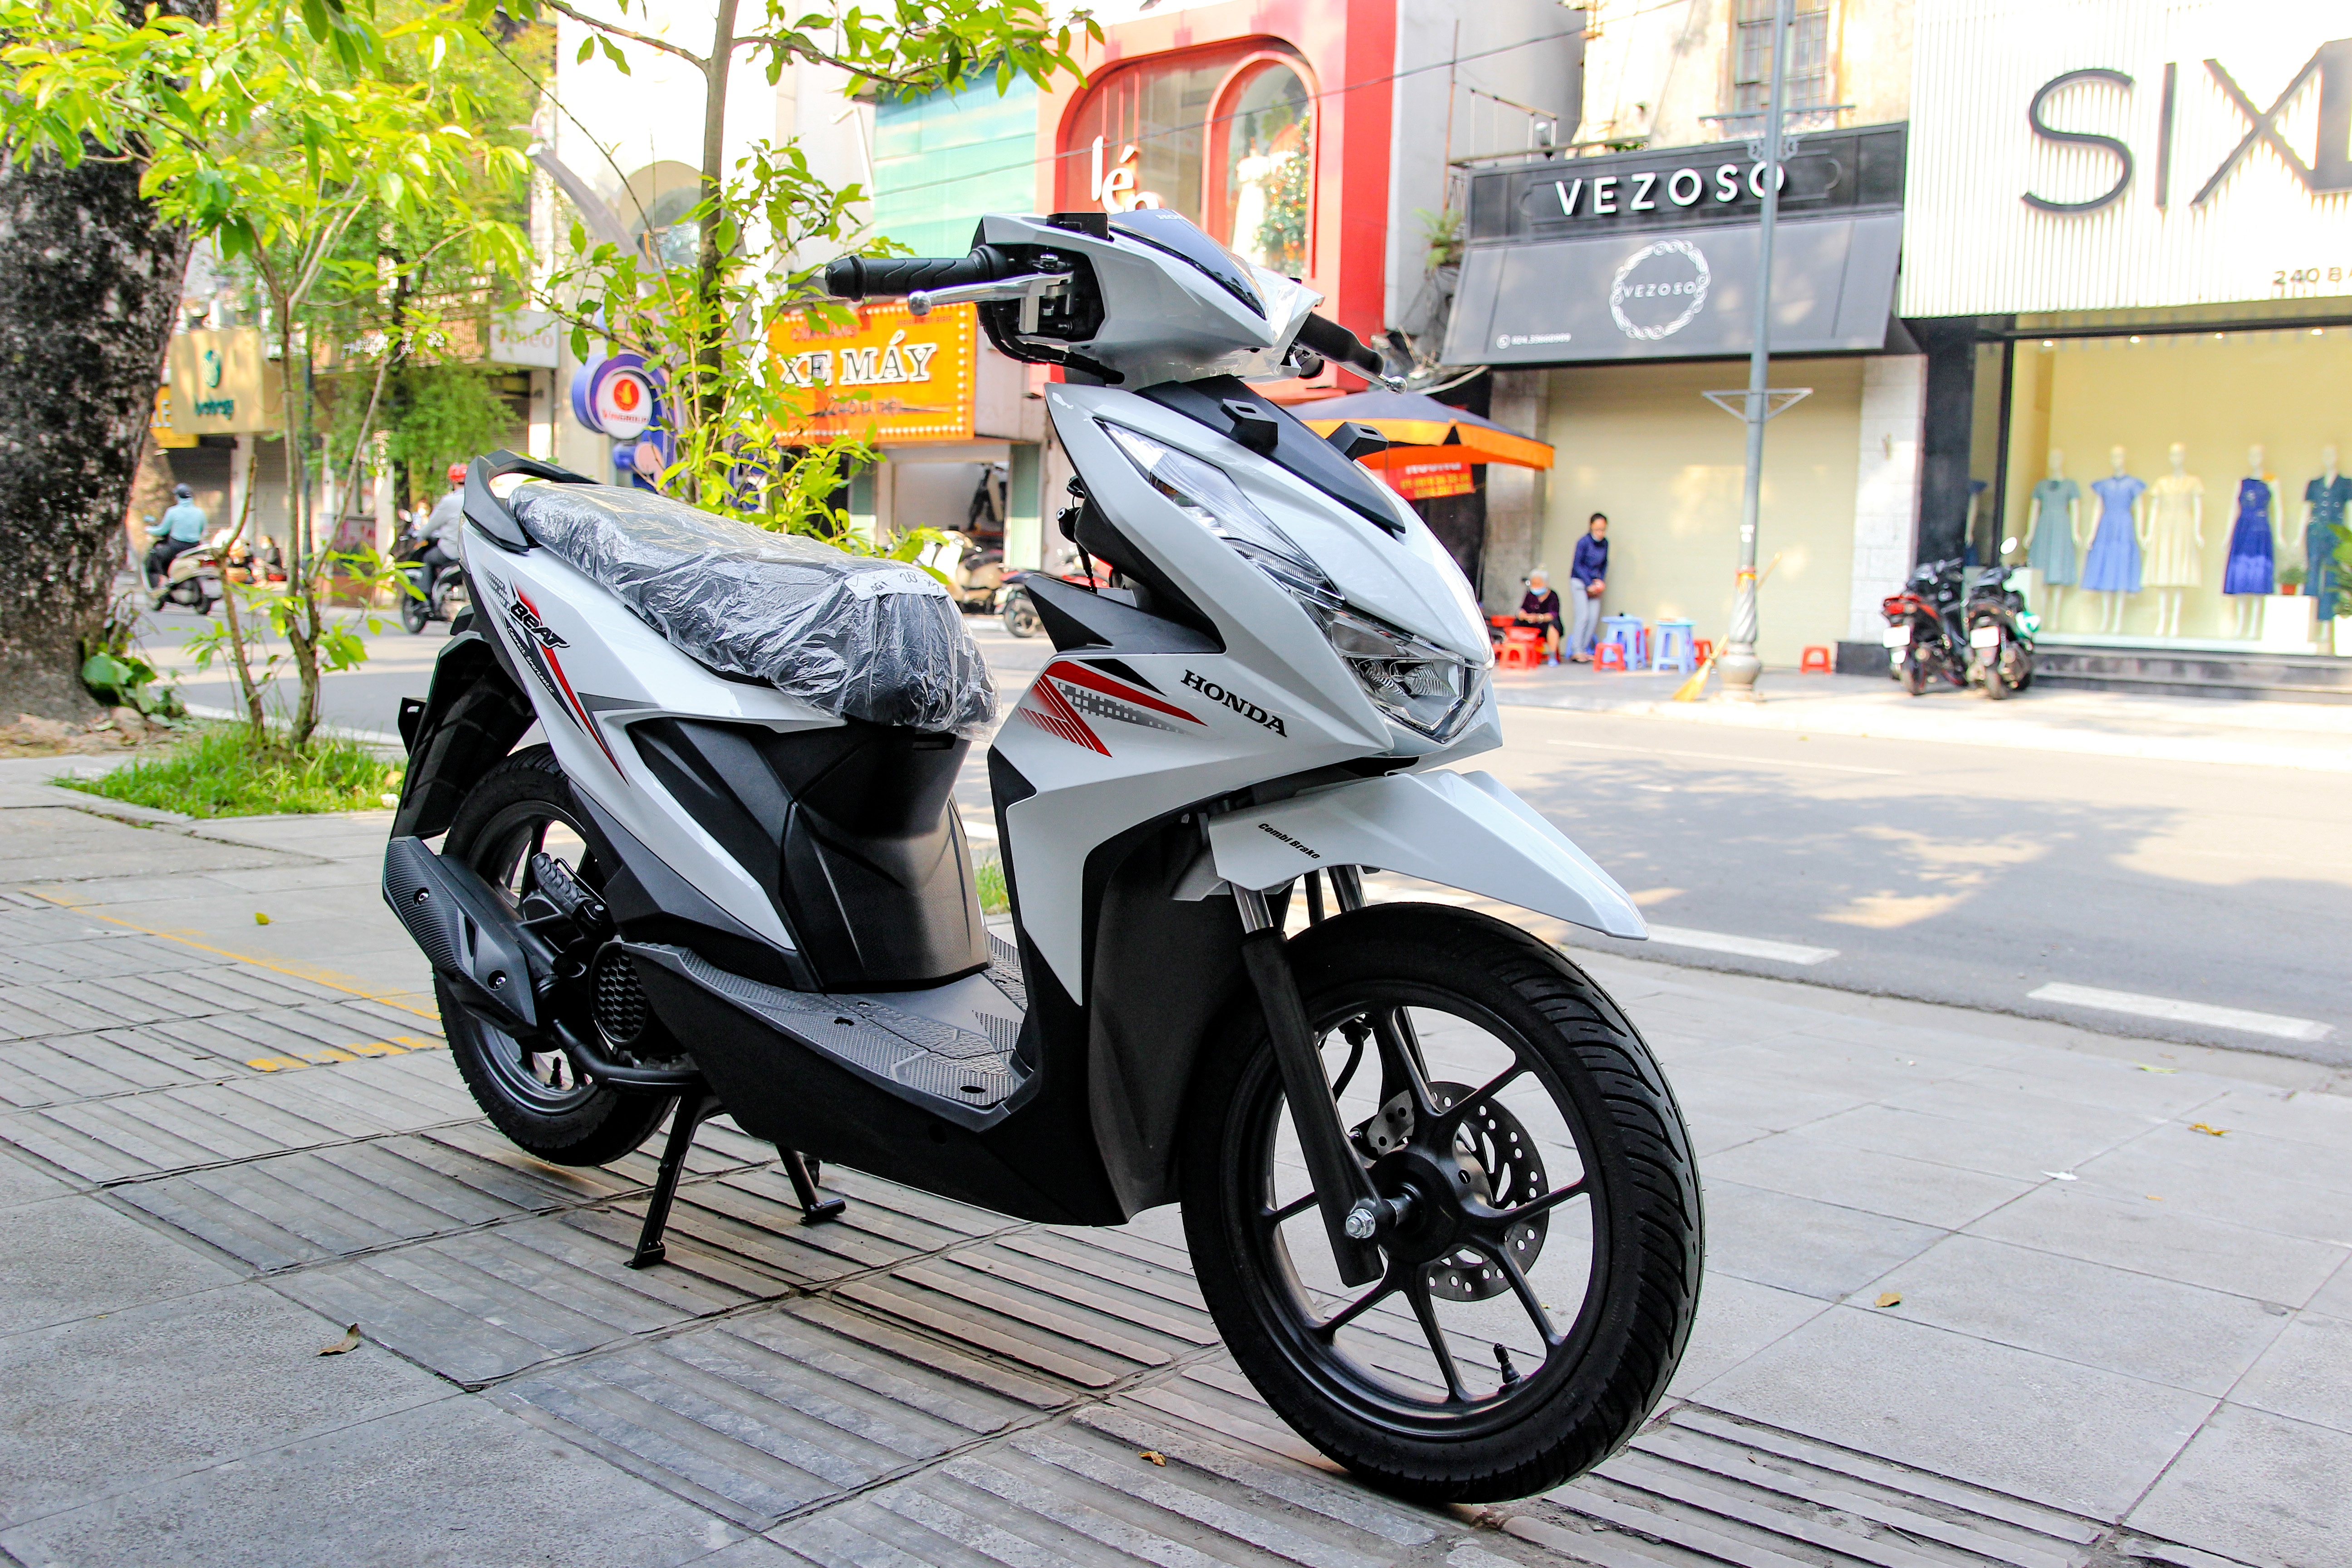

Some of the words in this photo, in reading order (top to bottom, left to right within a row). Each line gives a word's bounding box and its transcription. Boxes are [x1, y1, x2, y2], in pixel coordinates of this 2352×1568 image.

[1555, 160, 1786, 216] VEZOSO
[1623, 281, 1697, 299] VEZOSO
[2327, 266, 2352, 283] B
[779, 351, 832, 387] XE
[839, 329, 937, 386] MÁY
[508, 627, 526, 654] Compact
[1181, 669, 1287, 737] HONDA
[1258, 823, 1293, 843] Combi
[1289, 840, 1320, 859] Brake
